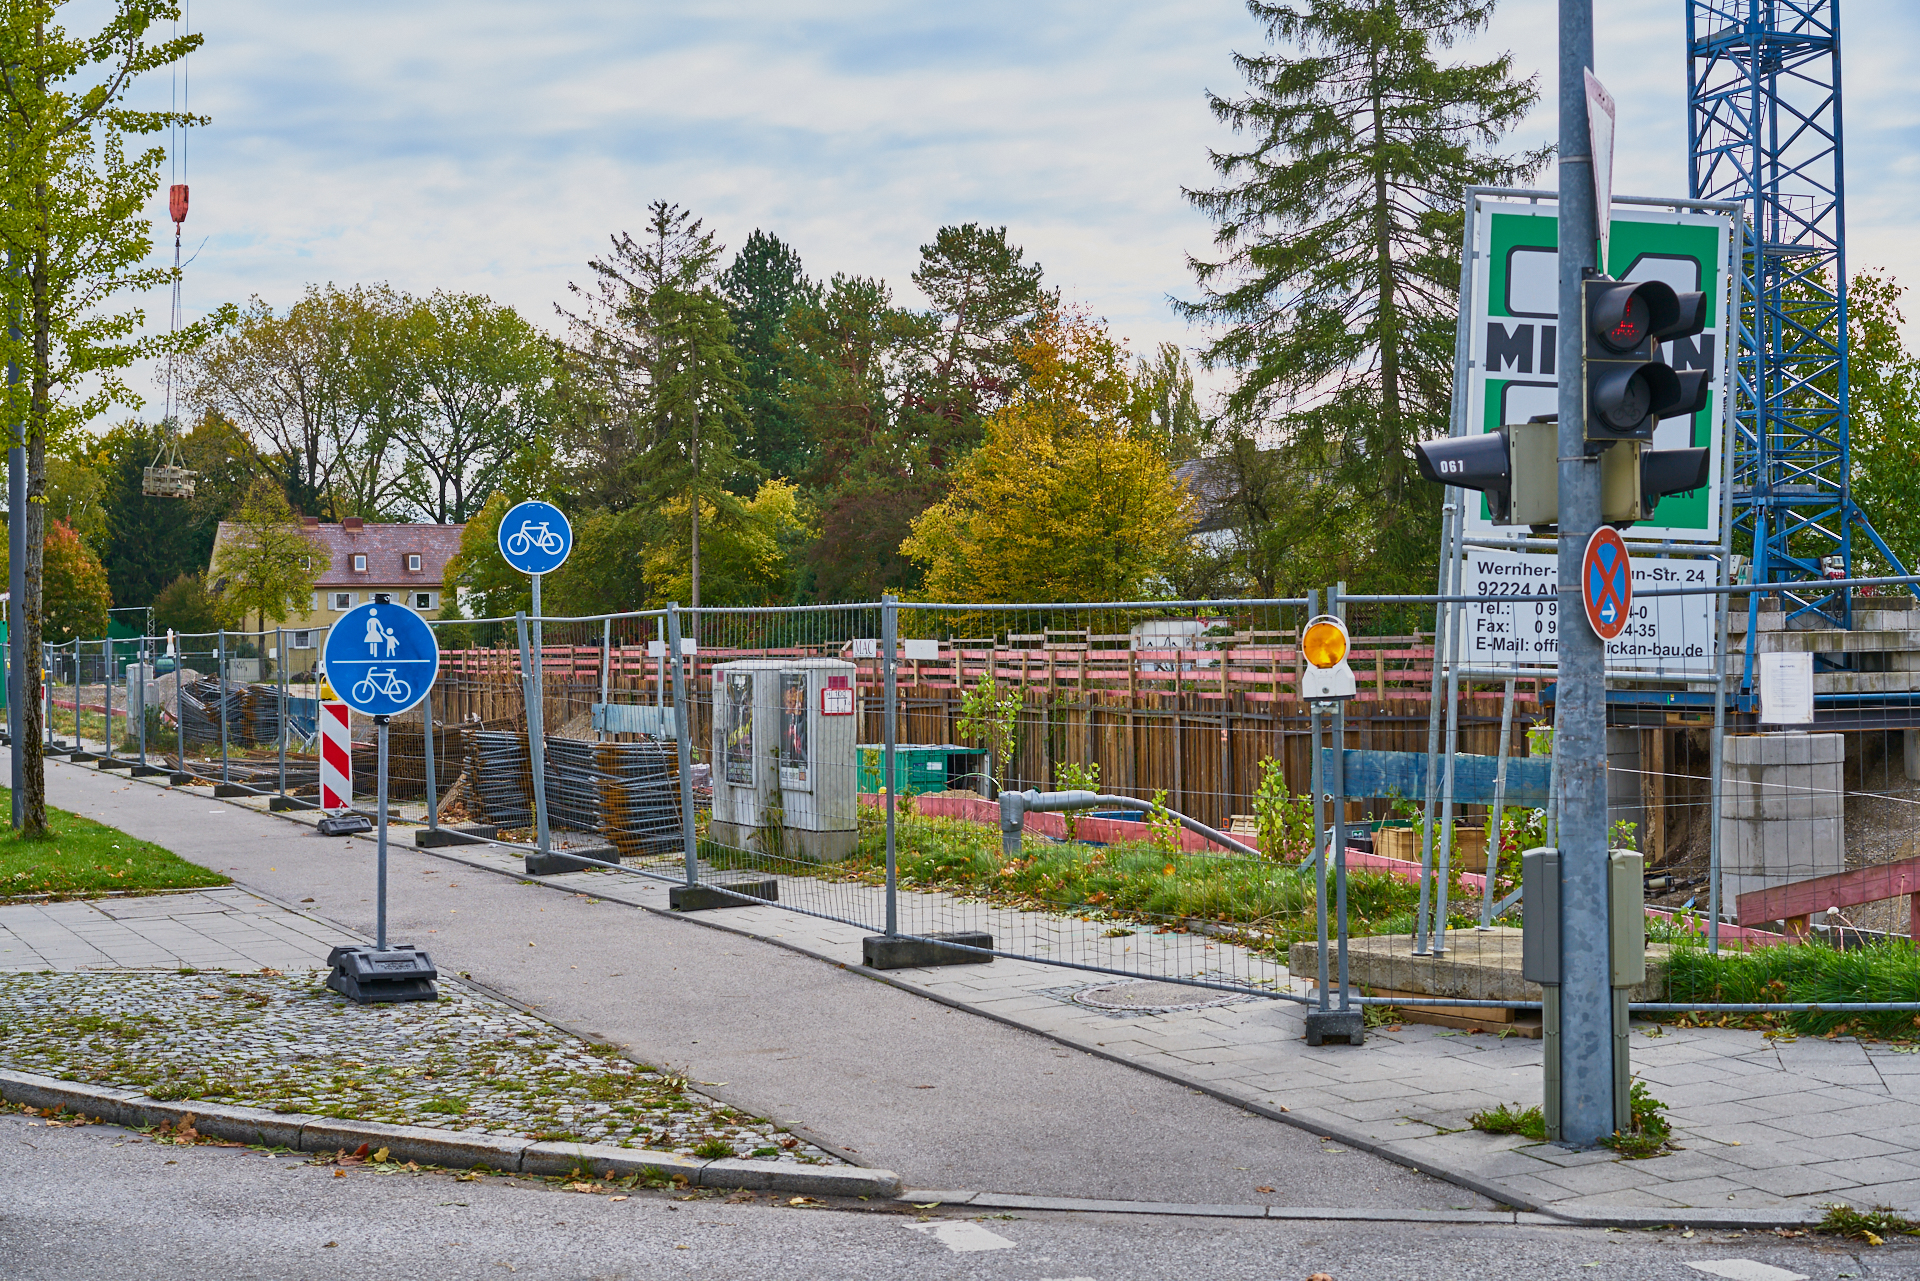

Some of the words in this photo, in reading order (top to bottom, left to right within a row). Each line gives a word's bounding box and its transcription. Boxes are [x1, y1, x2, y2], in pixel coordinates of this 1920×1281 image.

[1440, 460, 1464, 473] 061
[1685, 569, 1705, 582] 24
[1478, 581, 1531, 596] 92224
[1480, 602, 1510, 615] Tel.:
[1535, 603, 1543, 616] 0
[1477, 619, 1510, 633] Fax:
[1534, 620, 1543, 633] 0
[855, 640, 874, 654] MAC
[1476, 637, 1529, 651] E-Mail:
